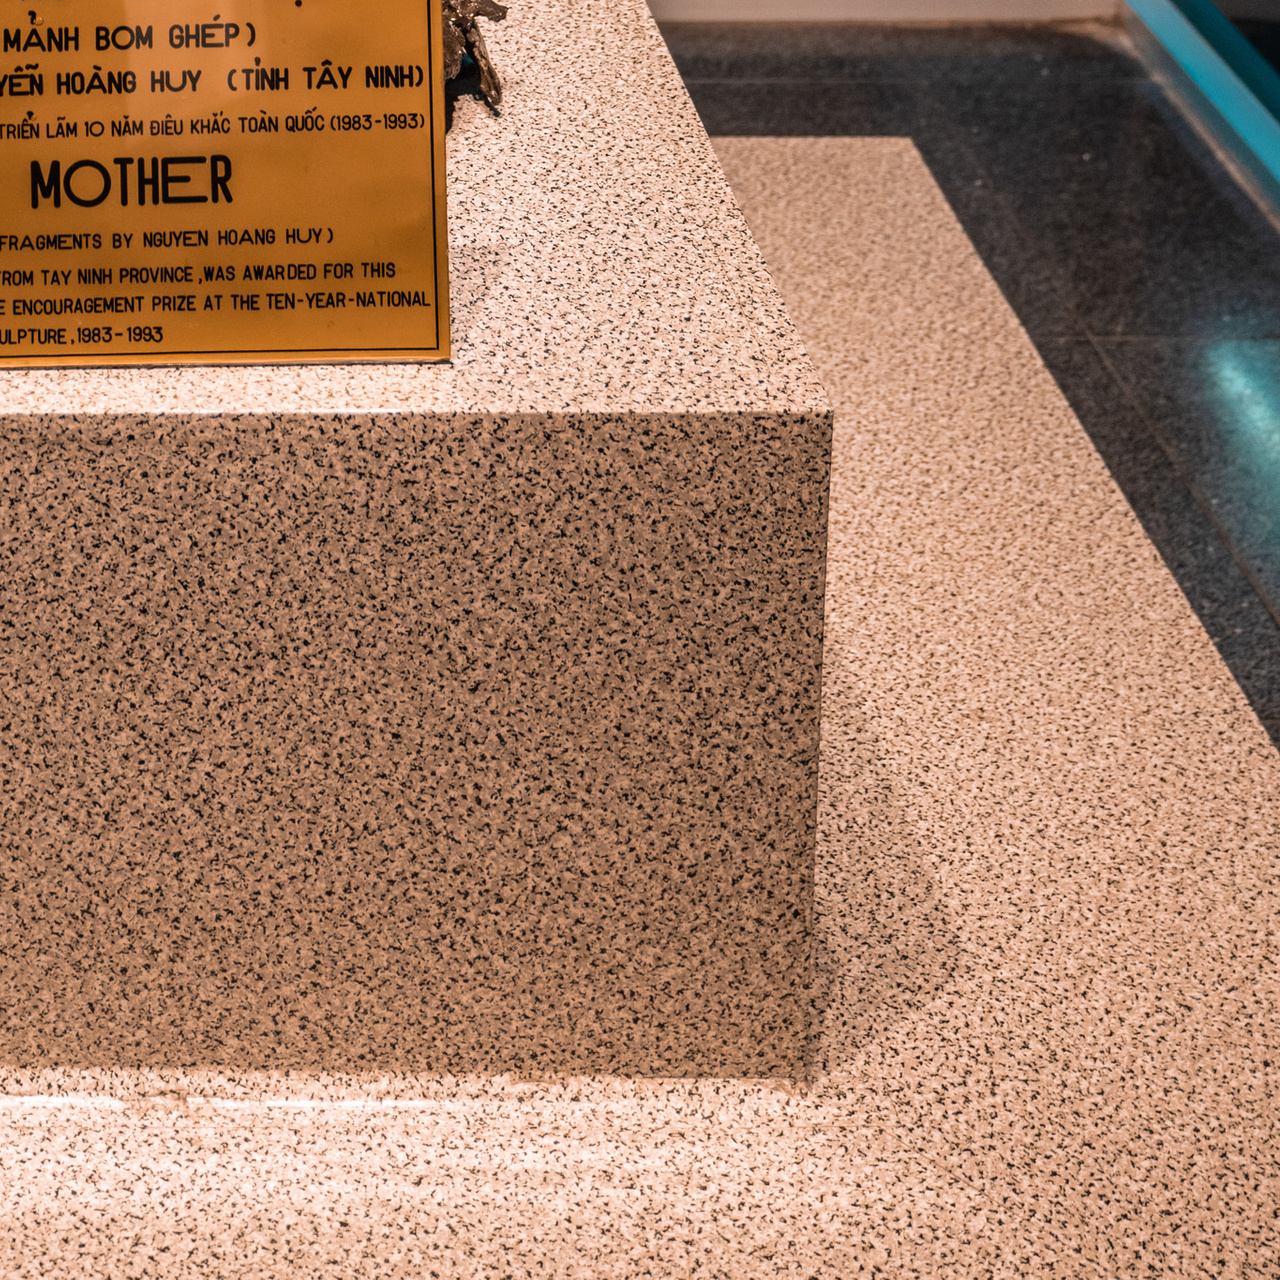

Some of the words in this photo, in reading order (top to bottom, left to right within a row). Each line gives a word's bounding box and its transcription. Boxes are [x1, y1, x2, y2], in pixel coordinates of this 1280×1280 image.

[95, 24, 154, 52] BOM
[56, 64, 137, 96] HOÀNG
[150, 69, 203, 94] HUY
[301, 58, 353, 91] TÂY
[364, 64, 424, 89] NINH)
[83, 120, 106, 138] 10
[110, 114, 144, 138] NĂM
[237, 109, 279, 134] TOÀN
[329, 112, 425, 132] (1983-1993)
[29, 153, 234, 210] MOTHER
[111, 232, 134, 250] BY
[142, 229, 209, 249] NGUYEN
[217, 228, 276, 246] HOANG
[285, 227, 334, 245] HUY)
[40, 269, 72, 286] TAY
[77, 267, 113, 285] NINH
[242, 263, 317, 281] AWARDED
[323, 262, 354, 280] FOR
[360, 261, 396, 279] THIS
[12, 295, 145, 316] ENCOURAGEMENT
[151, 294, 197, 312] PRIZE
[203, 294, 223, 311] AT
[230, 293, 261, 311] THE
[265, 290, 432, 311] TEN-YEAR-NATIONAL
[76, 325, 164, 344] 1983-1993
